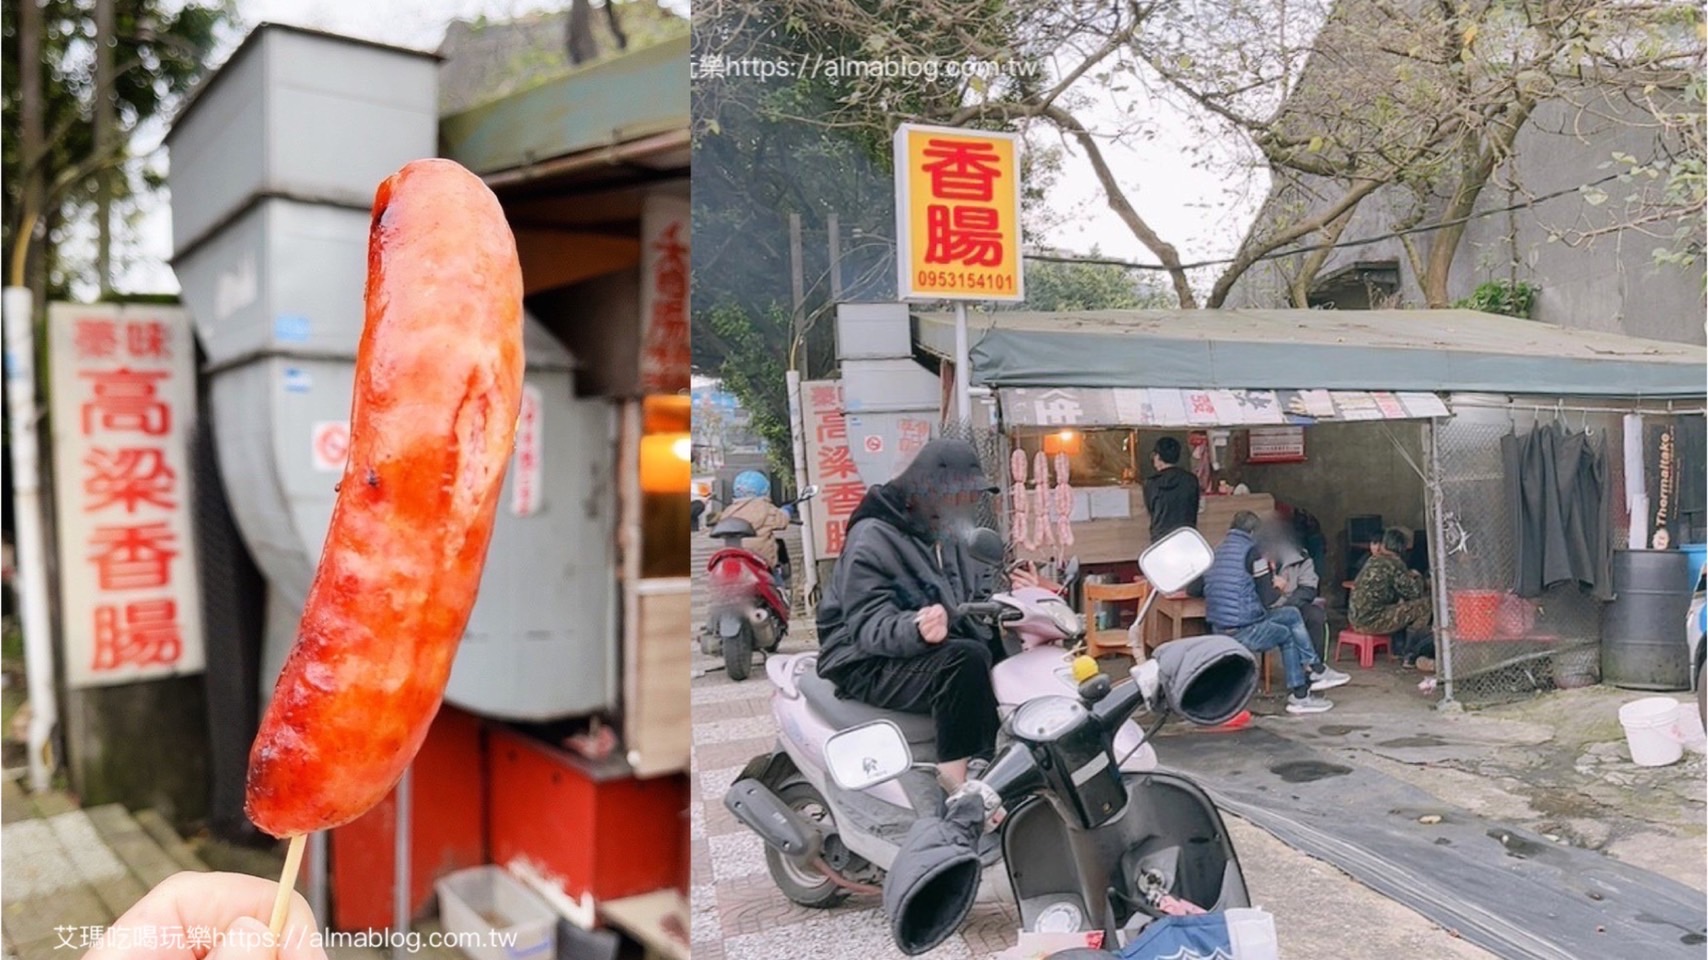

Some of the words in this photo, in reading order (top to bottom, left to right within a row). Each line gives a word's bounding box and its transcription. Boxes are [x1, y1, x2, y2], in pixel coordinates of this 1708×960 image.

[921, 138, 1004, 268] 香腸
[918, 270, 1013, 291] 0953154101
[77, 367, 183, 673] 高粱香腸
